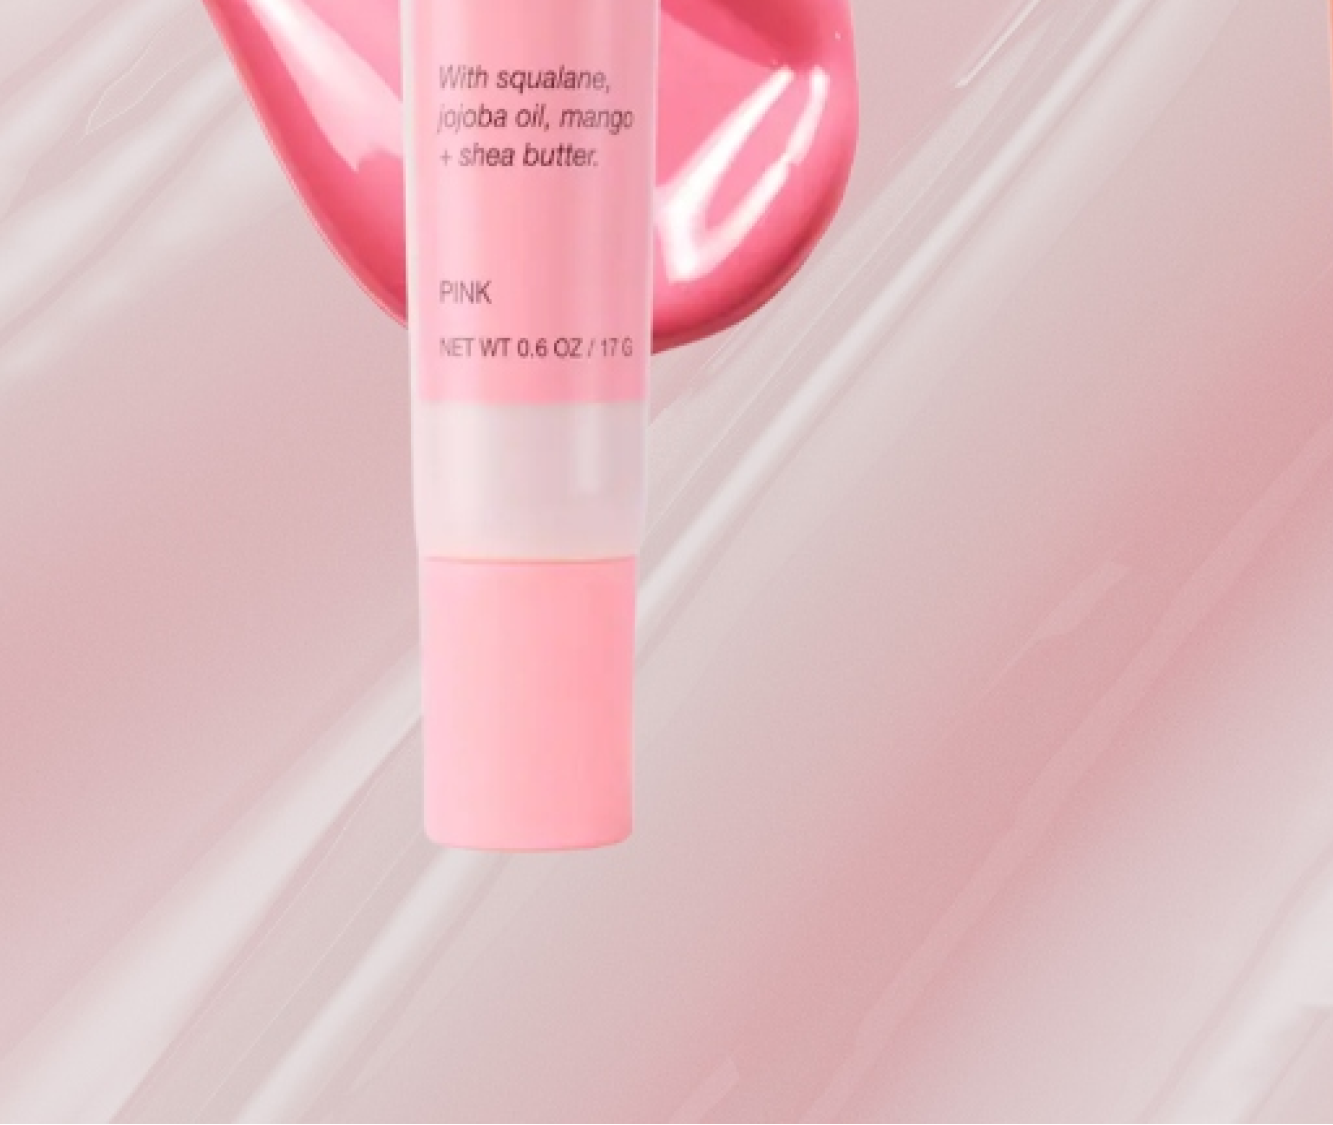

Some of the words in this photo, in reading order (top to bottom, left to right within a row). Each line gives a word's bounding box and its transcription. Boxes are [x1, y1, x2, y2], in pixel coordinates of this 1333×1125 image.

[438, 65, 488, 90] With
[496, 65, 611, 93] squalane,
[436, 103, 507, 134] jojoba
[515, 103, 550, 130] oil,
[559, 110, 633, 135] mango
[458, 142, 515, 167] shea
[522, 142, 599, 167] butter.
[439, 280, 492, 304] PINK
[439, 337, 474, 357] NET
[479, 337, 511, 357] WT
[517, 337, 548, 358] 0.6
[553, 337, 584, 359] OZ
